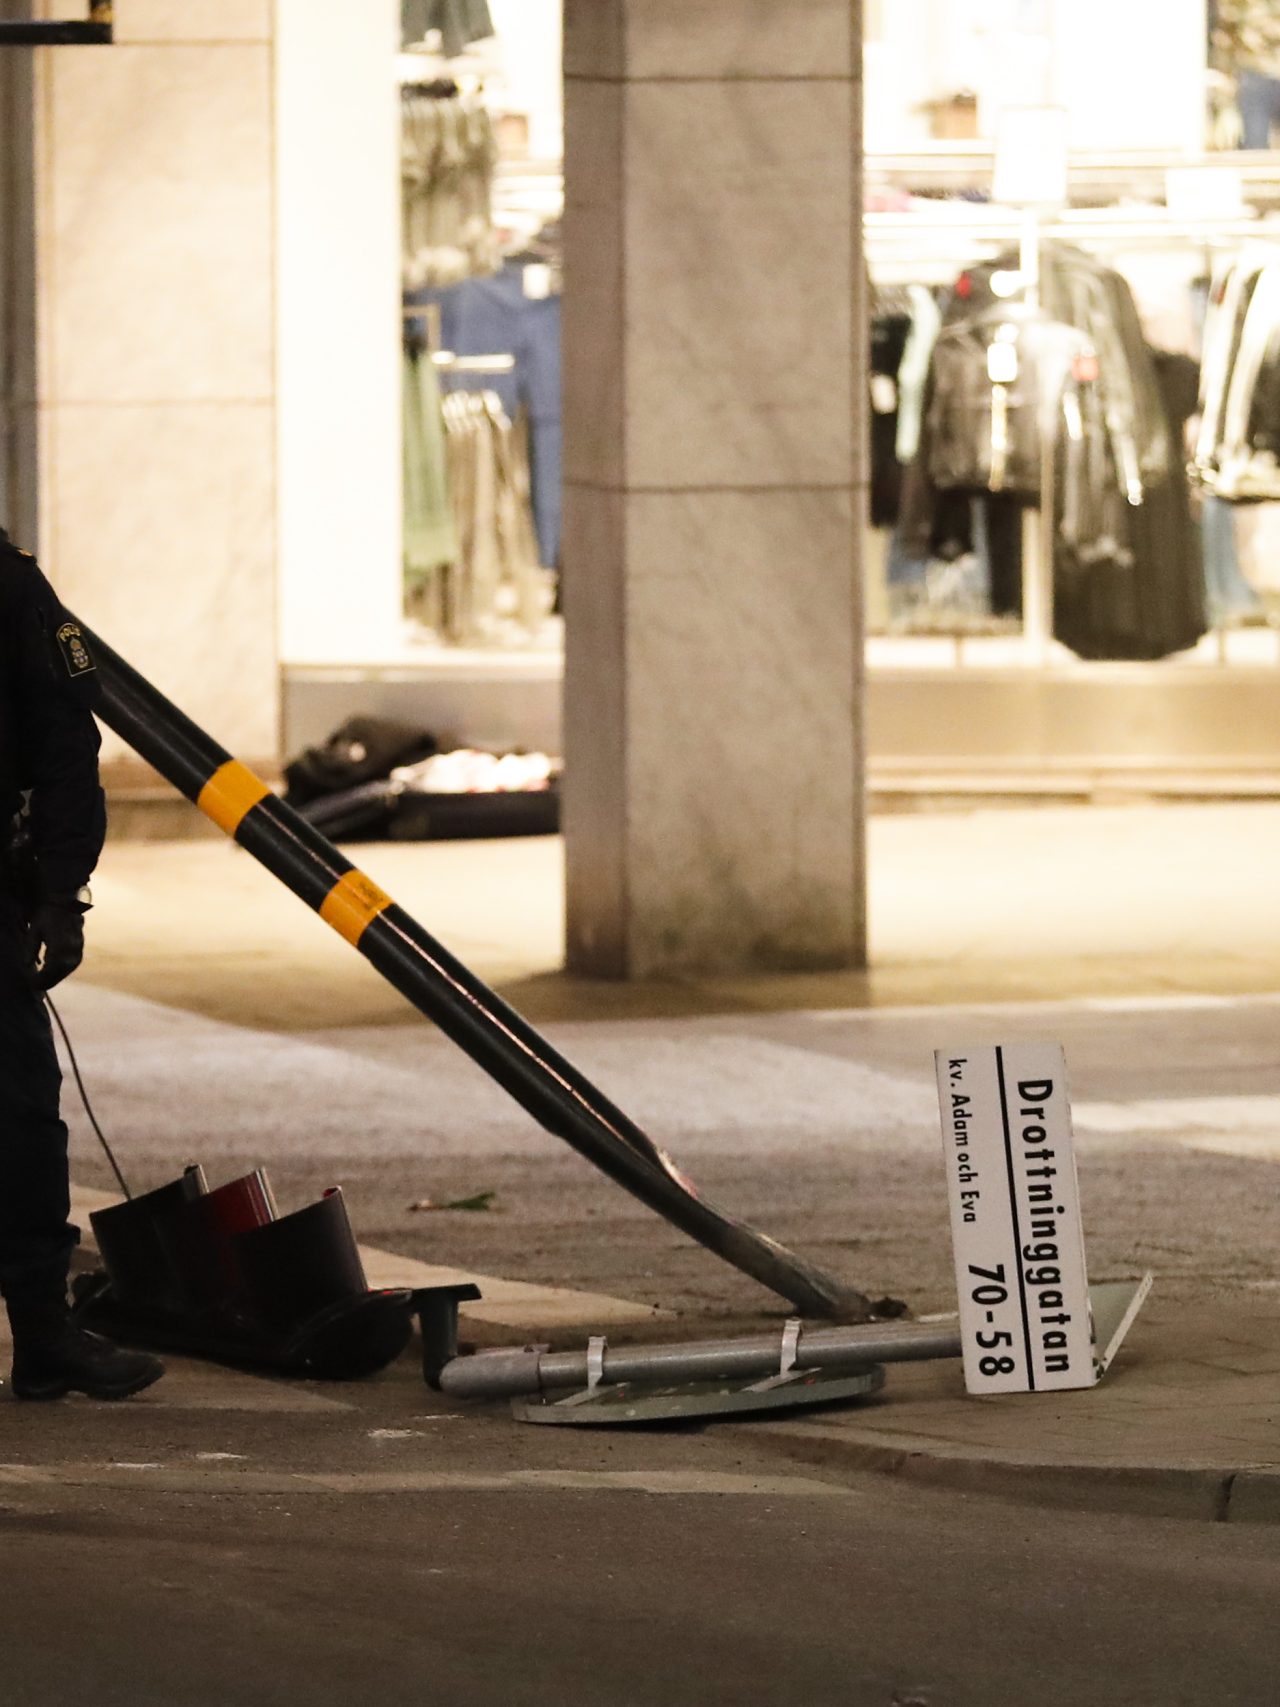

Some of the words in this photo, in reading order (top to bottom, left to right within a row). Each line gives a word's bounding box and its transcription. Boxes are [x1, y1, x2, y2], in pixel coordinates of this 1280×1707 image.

[948, 1058, 968, 1088] kv.
[951, 1093, 973, 1147] Adam
[957, 1152, 979, 1183] och
[960, 1190, 980, 1223] Eva
[1017, 1079, 1072, 1373] Drottninggatan
[967, 1263, 1016, 1377] 70-58
